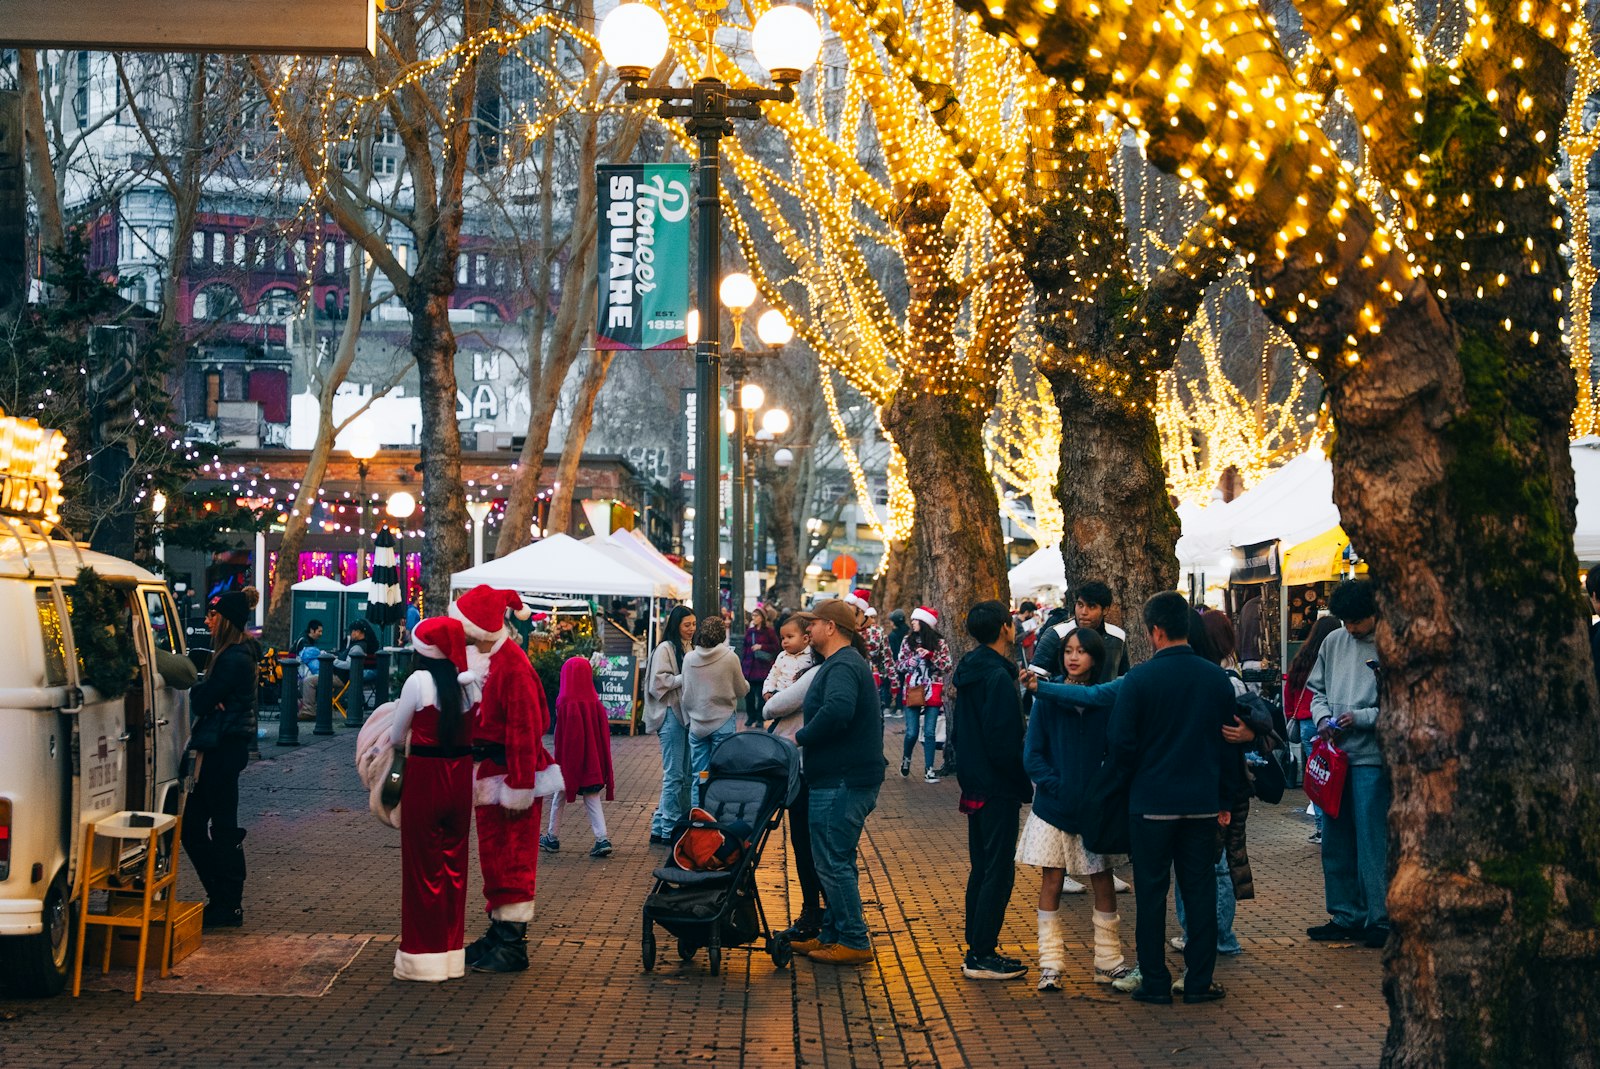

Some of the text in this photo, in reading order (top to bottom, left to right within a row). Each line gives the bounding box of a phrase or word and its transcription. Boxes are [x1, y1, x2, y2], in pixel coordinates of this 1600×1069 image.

[606, 176, 635, 329] SQUARE
[636, 175, 689, 296] Pioneer
[647, 320, 685, 330] 1852
